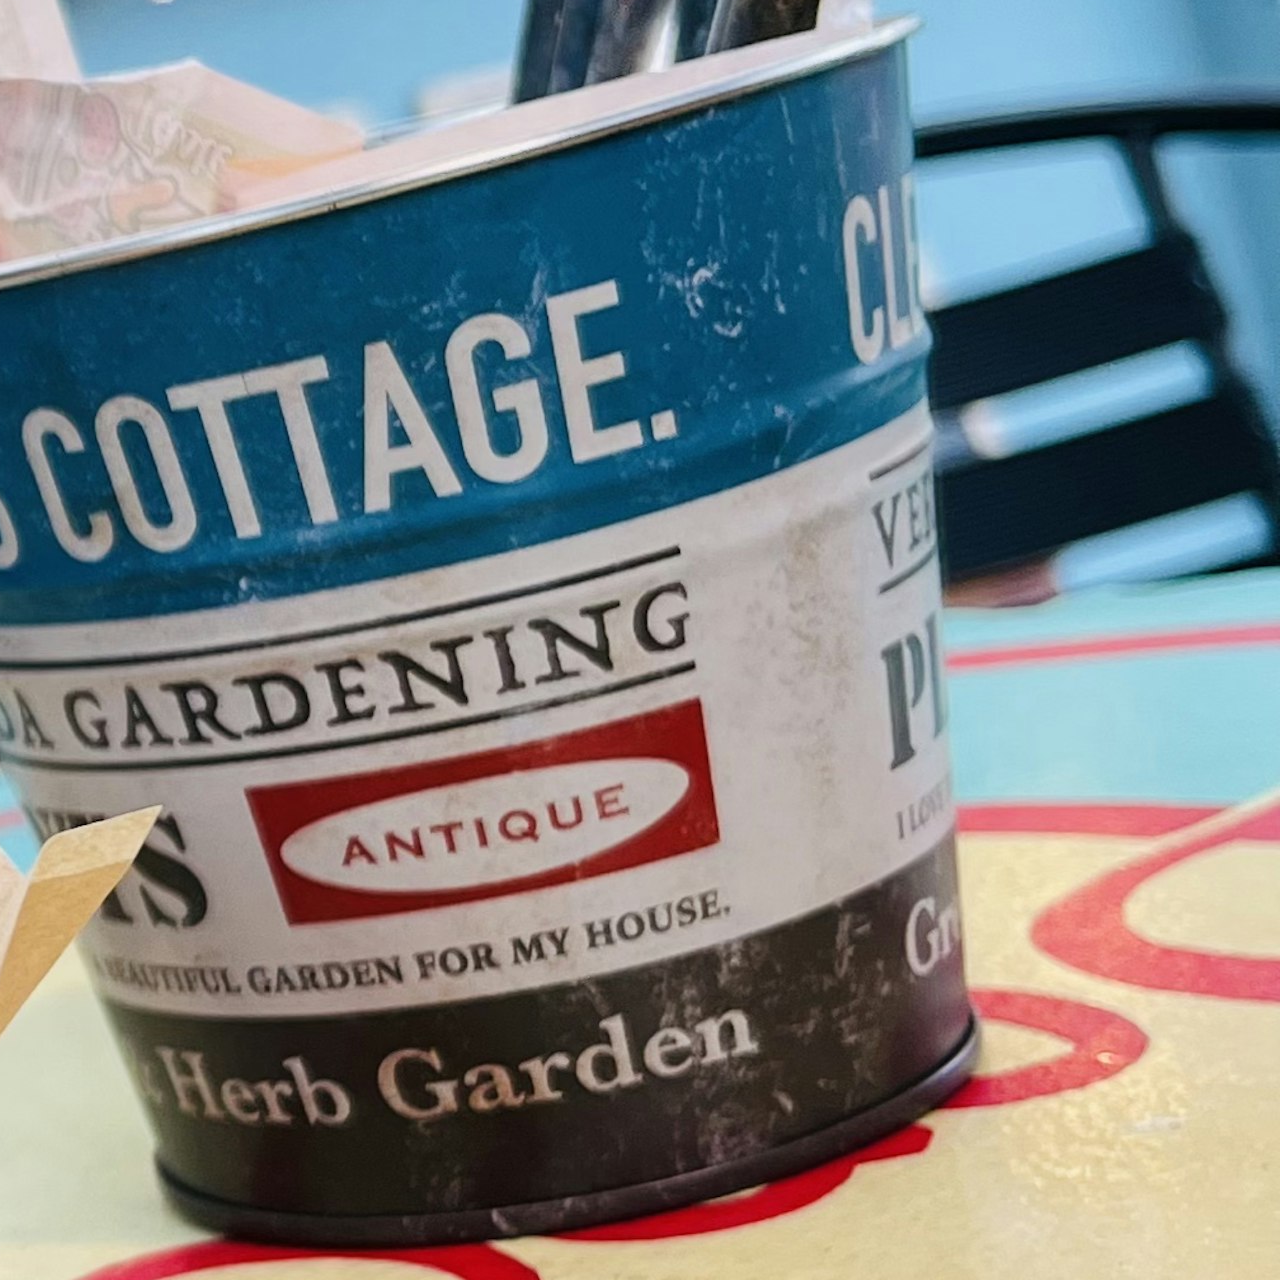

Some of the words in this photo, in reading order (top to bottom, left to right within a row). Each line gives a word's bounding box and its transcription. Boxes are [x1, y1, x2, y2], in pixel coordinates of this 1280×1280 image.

[22, 278, 679, 563] COTTAGE.
[62, 581, 691, 749] GARDENING
[341, 782, 631, 867] ANTIQUE
[246, 954, 405, 996] GARDEN
[417, 940, 500, 980] FOR
[511, 925, 571, 966] MY
[586, 888, 732, 951] HOUSE.
[154, 1045, 351, 1127] Herb
[376, 1006, 762, 1122] Garden
